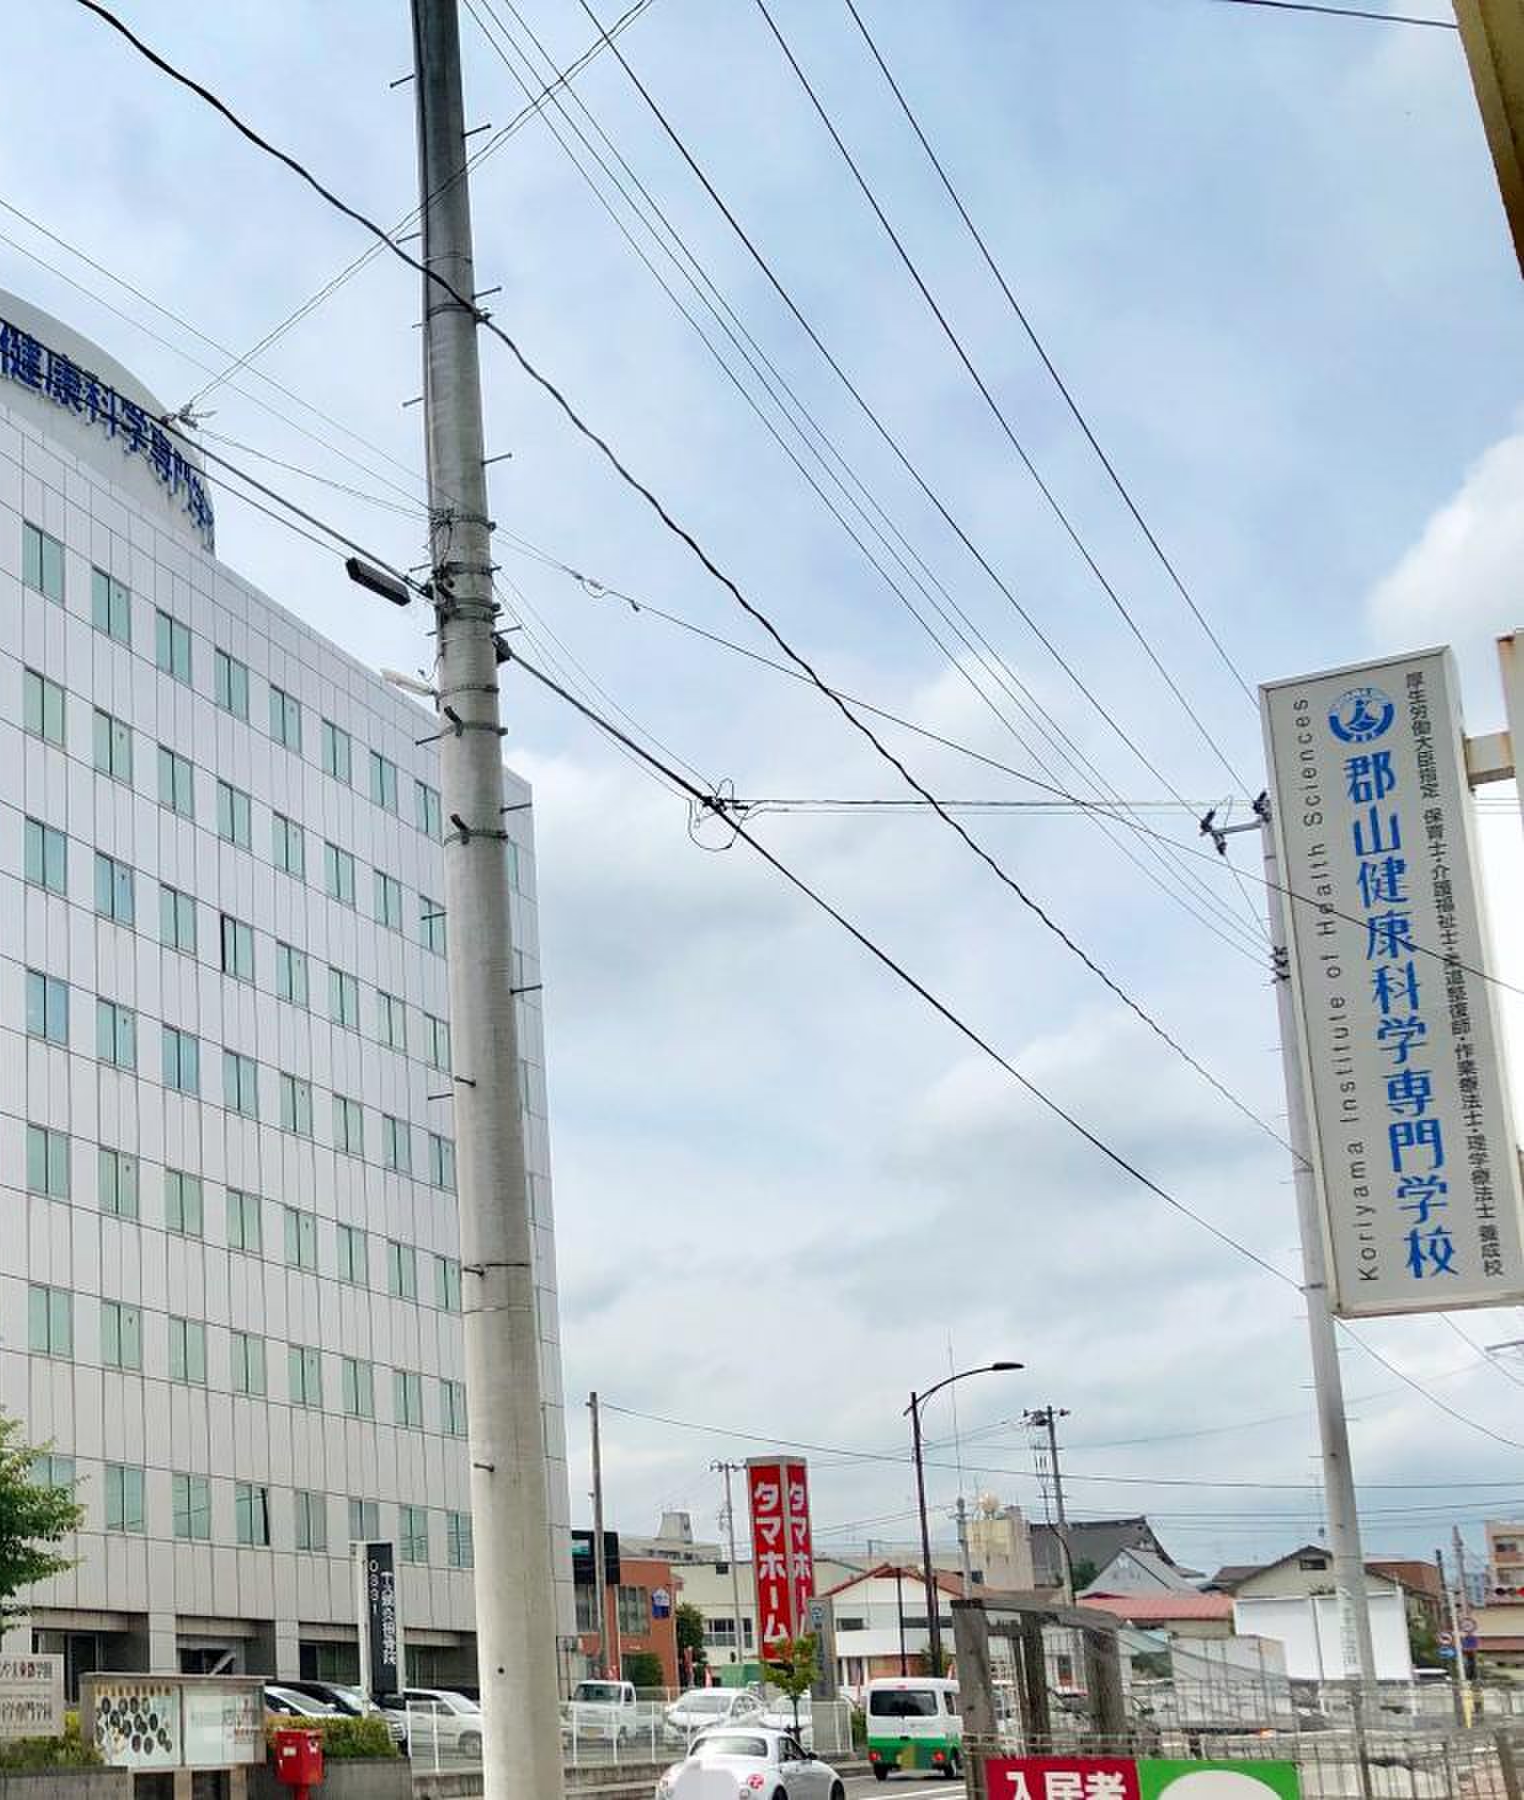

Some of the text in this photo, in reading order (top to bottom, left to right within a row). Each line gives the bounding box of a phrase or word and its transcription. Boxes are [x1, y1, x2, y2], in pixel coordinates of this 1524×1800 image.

[1293, 699, 1379, 1281] Koriyama Institute of Health Sciences
[1343, 750, 1458, 1279] 郡山健康科学専門学校
[754, 1482, 790, 1643] タマホーム
